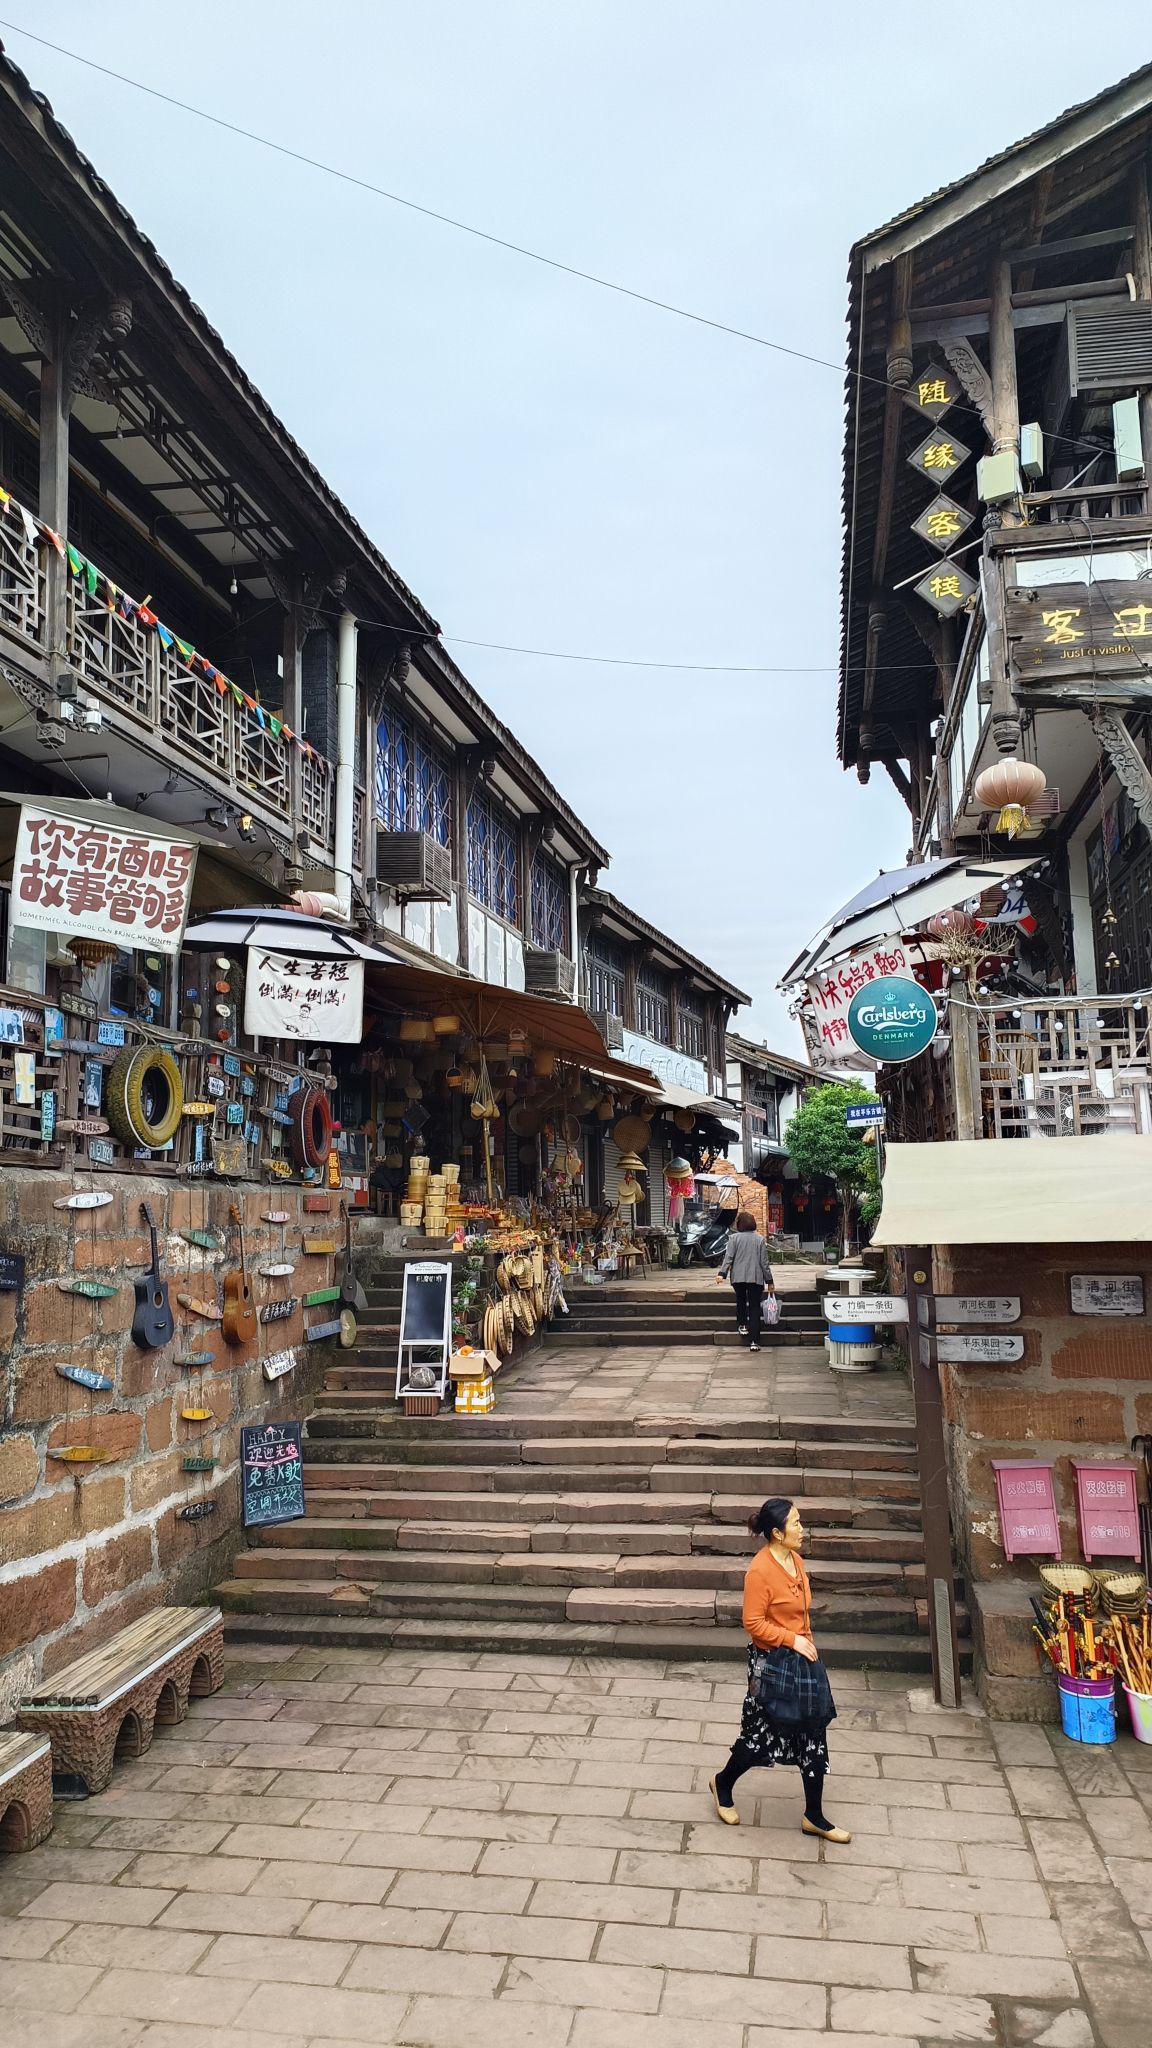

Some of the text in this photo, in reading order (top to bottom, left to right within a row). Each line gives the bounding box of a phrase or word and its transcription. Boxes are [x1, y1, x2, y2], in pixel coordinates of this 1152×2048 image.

[1060, 648, 1084, 659] Just
[1087, 648, 1096, 656] a
[26, 819, 195, 888] 你有酒吗
[20, 858, 186, 933] 故事管够
[63, 920, 96, 931] ALCOHOL
[98, 926, 112, 934] CAN
[114, 930, 135, 940] BRING
[259, 956, 350, 982] 人生苦短
[71, 1000, 95, 1018] 营业中
[857, 1003, 926, 1029] Carlsberg
[872, 1031, 915, 1041] DENMARK
[1086, 1280, 1137, 1293] 清河街
[847, 1300, 893, 1310] 竹编一条街
[962, 1338, 1000, 1348] 平乐果园
[249, 1429, 286, 1446] HAPPY
[249, 1443, 298, 1462] 欢迎光临
[248, 1460, 302, 1488] 免费K歌
